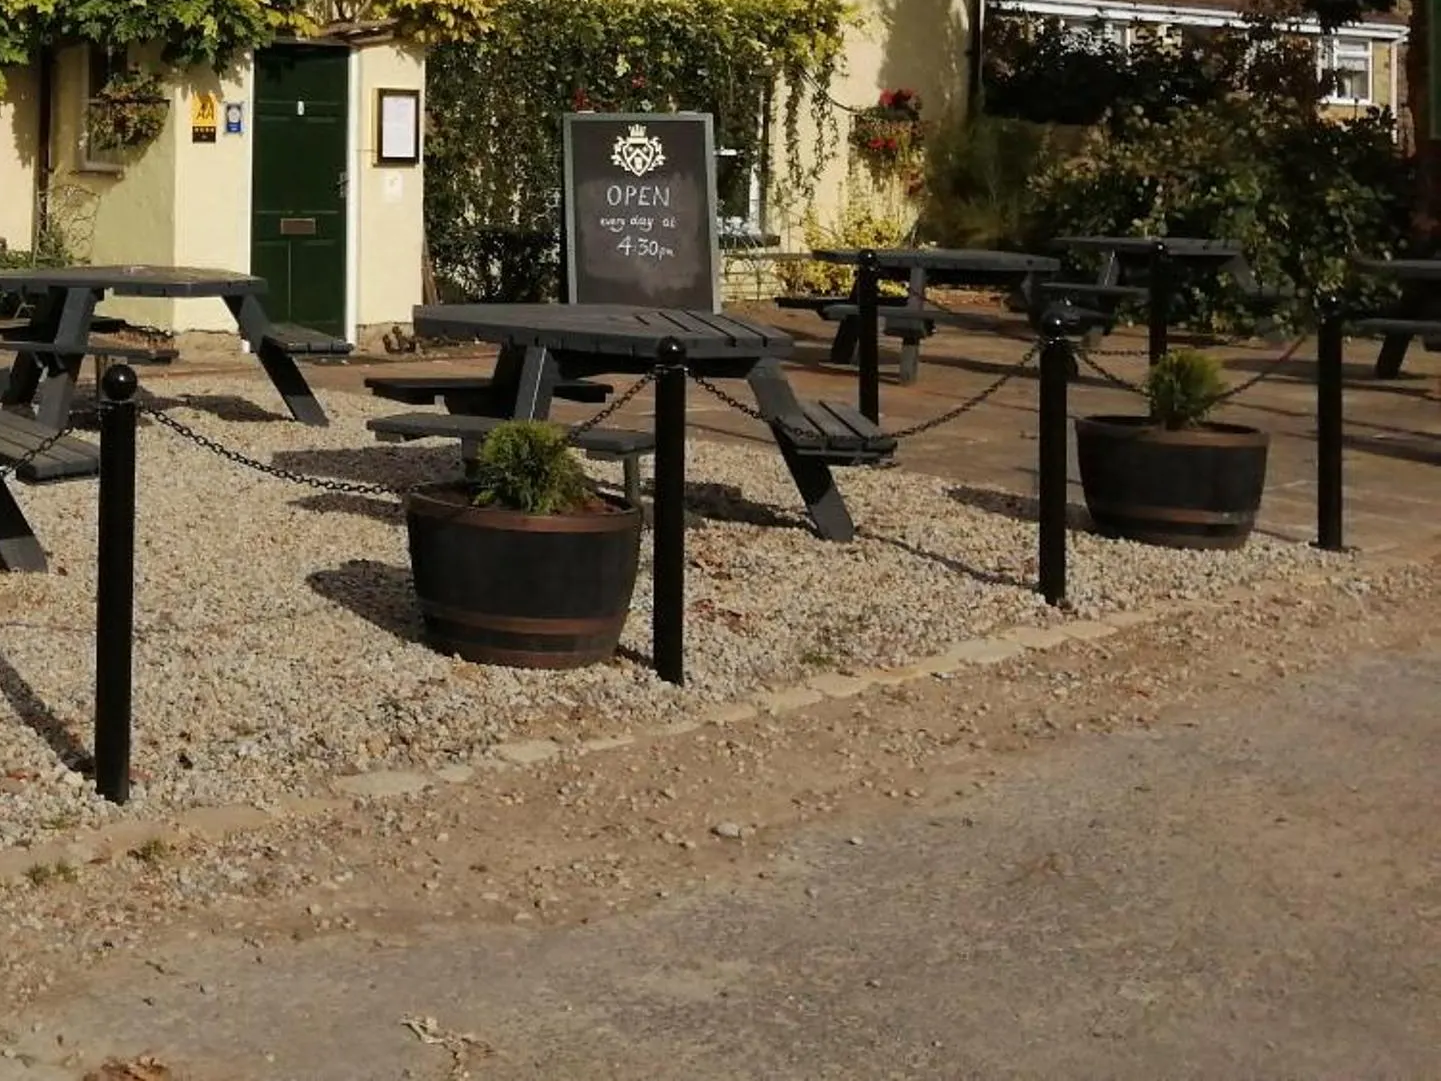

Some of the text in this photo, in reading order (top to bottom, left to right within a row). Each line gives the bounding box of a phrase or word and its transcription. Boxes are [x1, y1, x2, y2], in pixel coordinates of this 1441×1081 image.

[606, 184, 670, 207] OPEN
[600, 214, 676, 233] every day at
